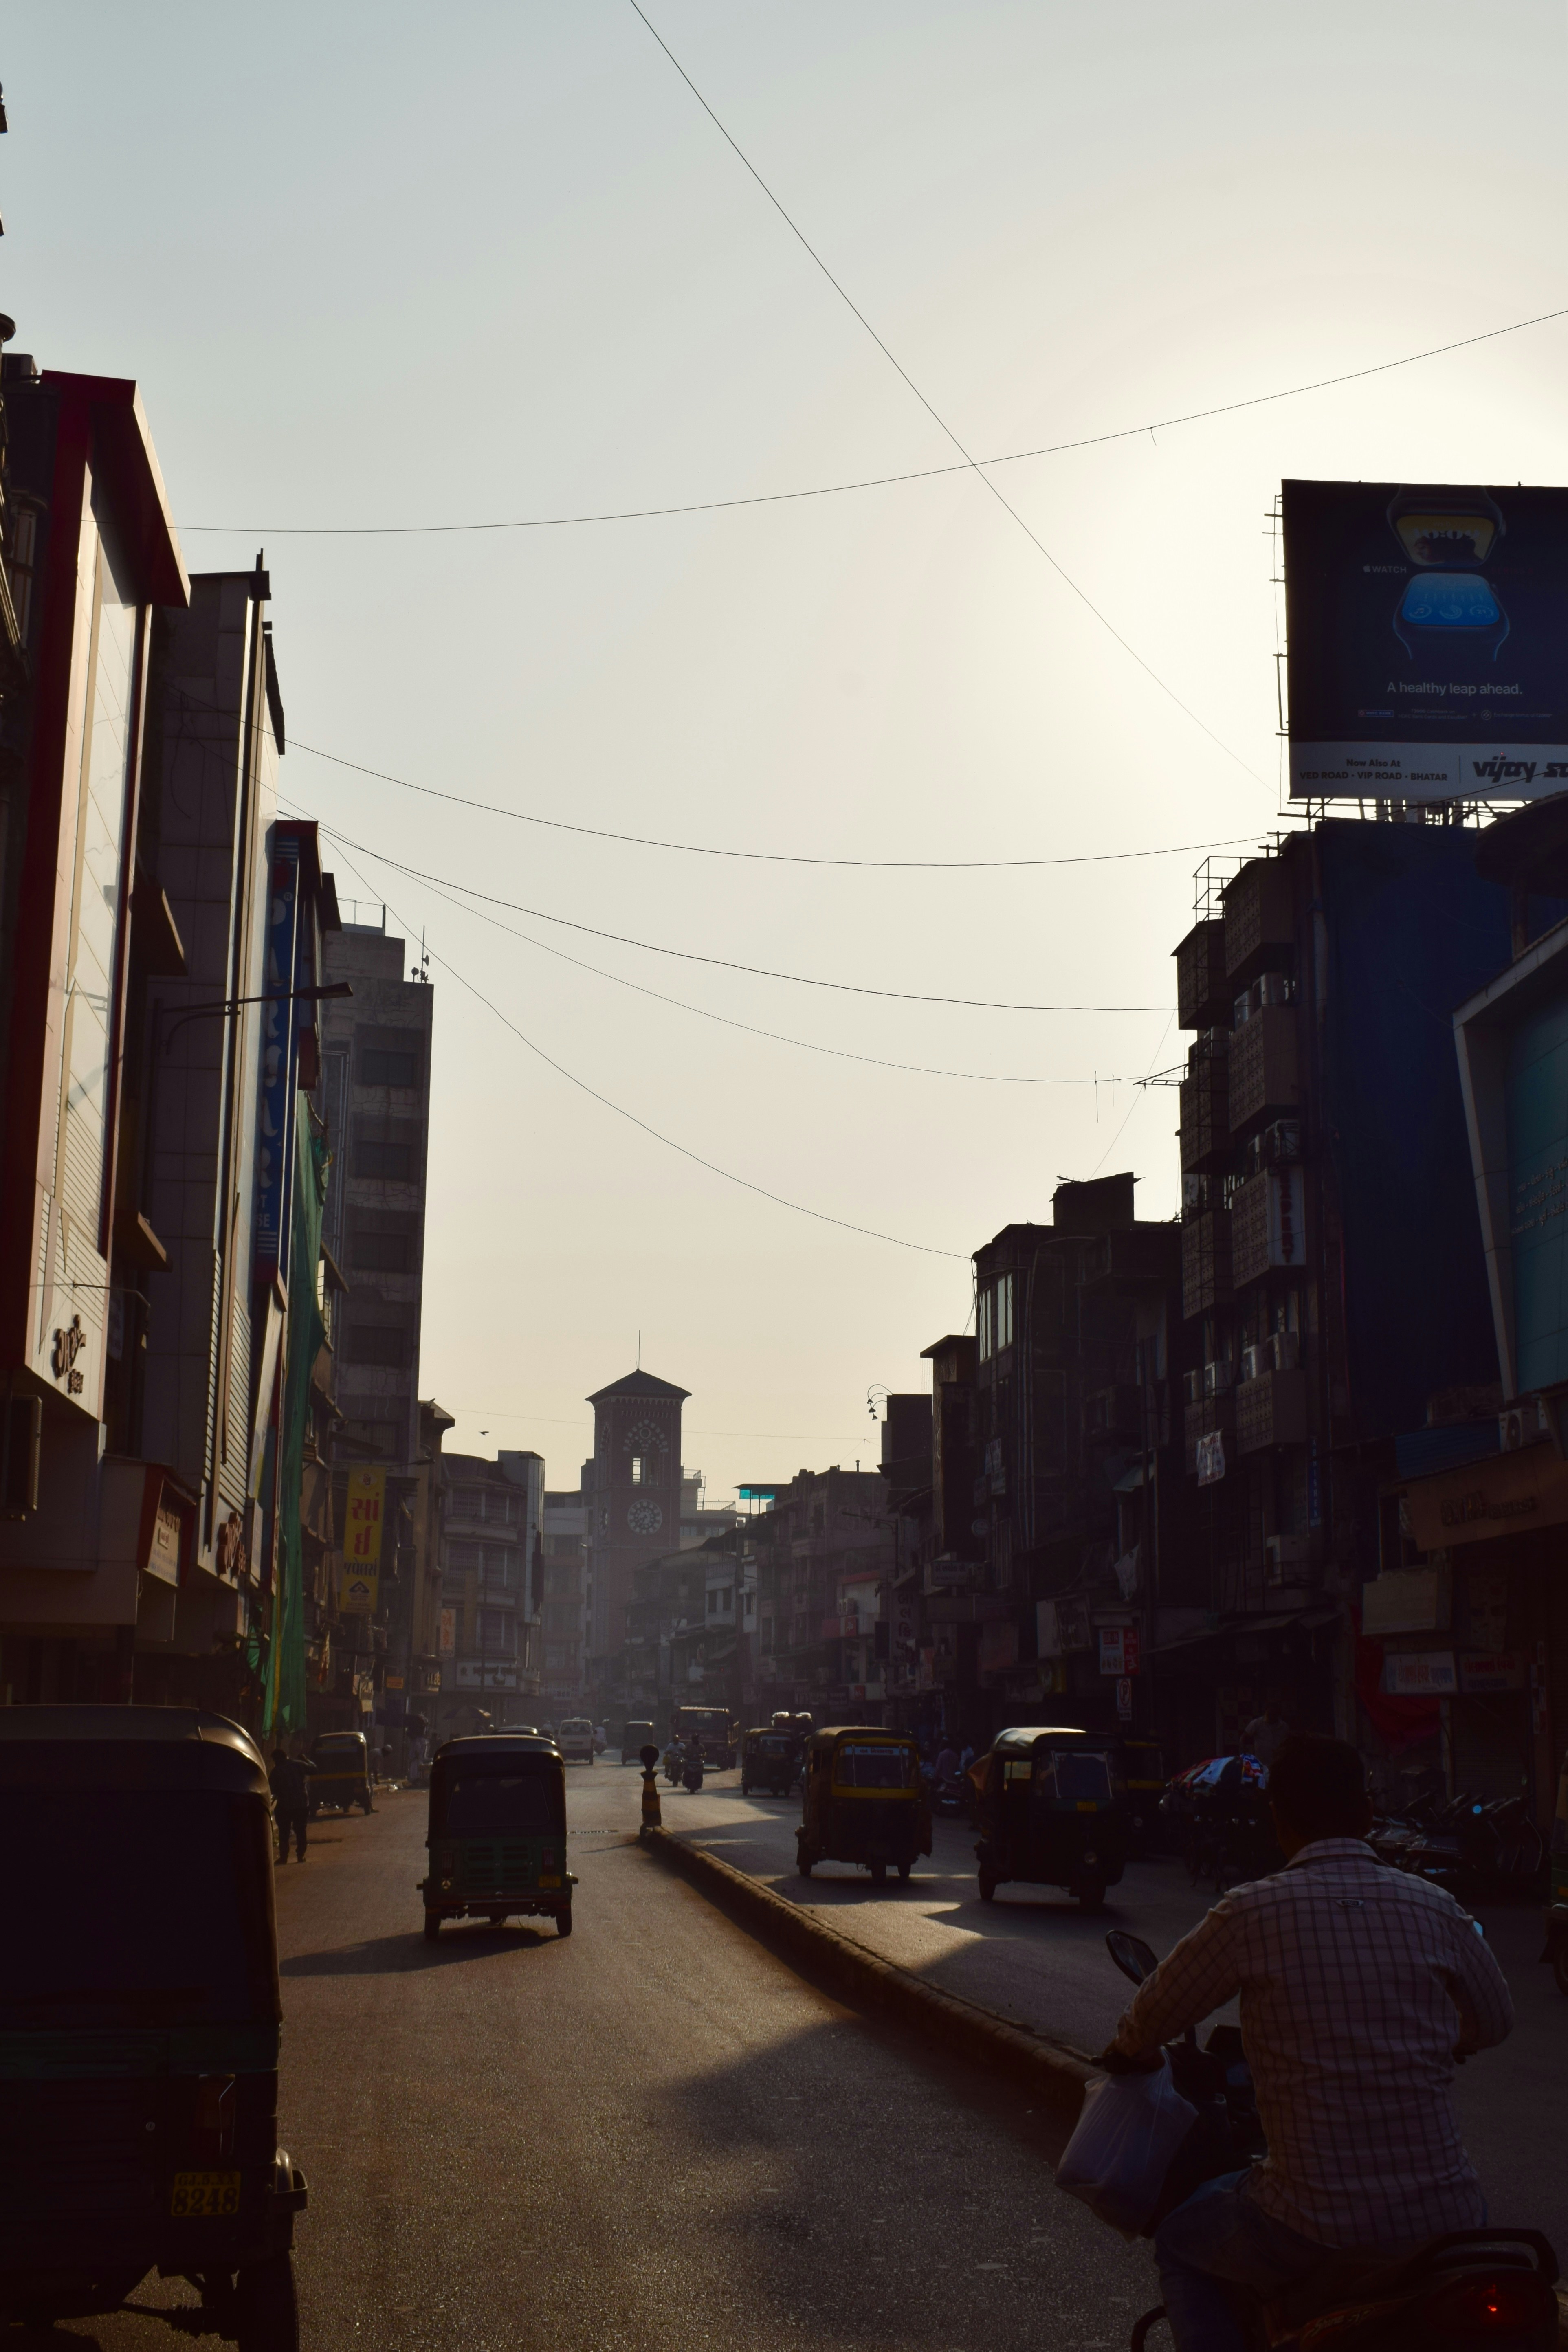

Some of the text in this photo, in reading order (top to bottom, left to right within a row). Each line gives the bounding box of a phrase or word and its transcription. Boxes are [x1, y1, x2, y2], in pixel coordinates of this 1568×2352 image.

[1387, 682, 1522, 697] A healthy leap ahead.
[1346, 759, 1366, 767] Now
[1369, 759, 1388, 767] Also
[1375, 772, 1402, 780] ROAD
[1410, 773, 1447, 782] BHATAR
[173, 2187, 238, 2214] 8248
